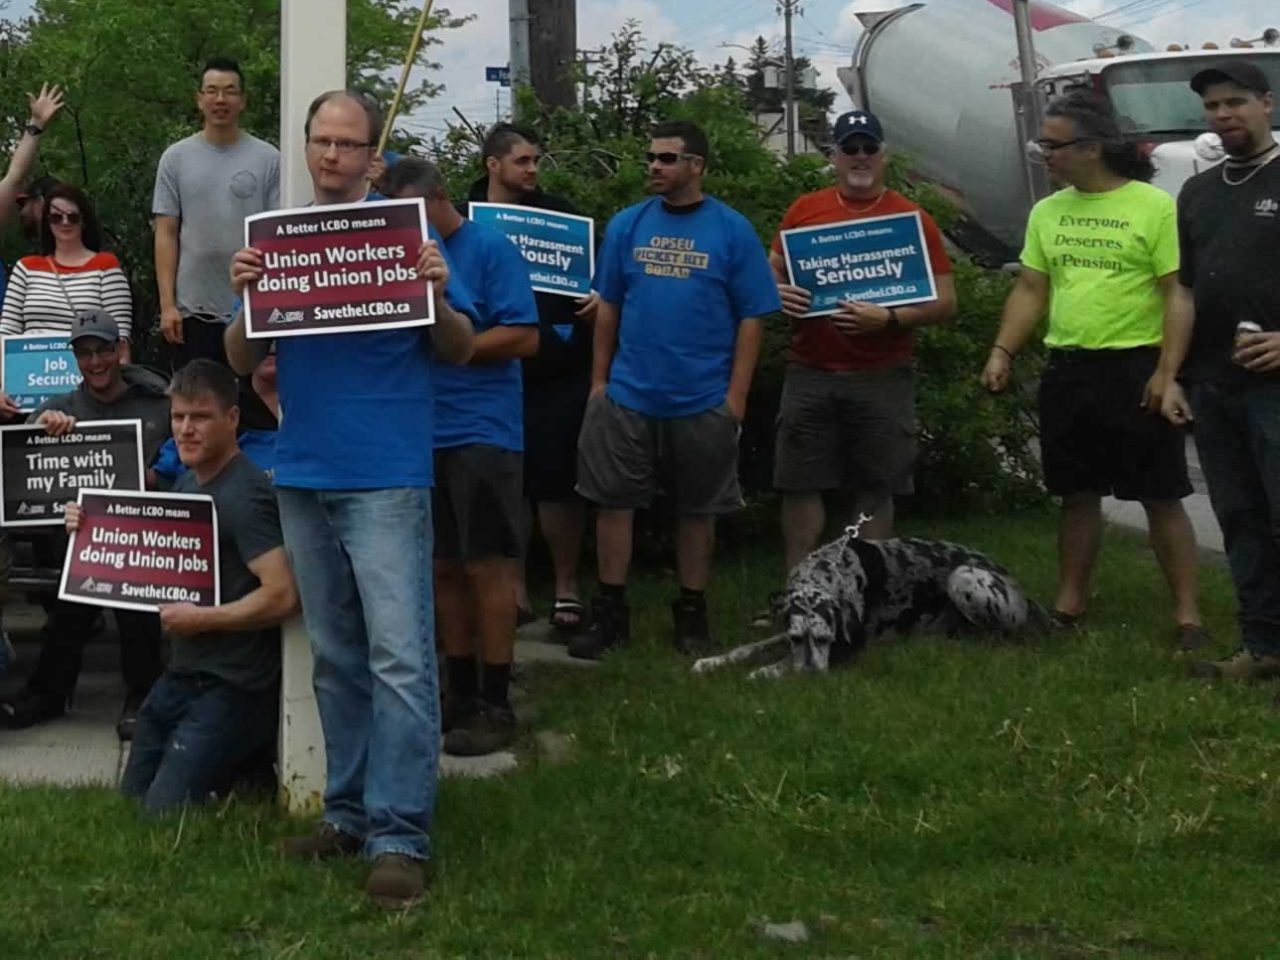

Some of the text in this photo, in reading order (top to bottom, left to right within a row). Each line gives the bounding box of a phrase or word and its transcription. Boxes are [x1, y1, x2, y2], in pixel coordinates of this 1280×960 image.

[276, 217, 387, 236] A Better LCBO means
[1058, 214, 1130, 231] Everyone
[519, 233, 585, 255] Harassment
[650, 235, 696, 251] OPSEU
[1054, 233, 1123, 250] Deserves
[264, 242, 406, 269] Union Workers
[797, 244, 917, 272] Taking Harassment
[1062, 254, 1122, 272] Pension
[257, 263, 418, 293] doing Union Jobs
[815, 259, 904, 286] Seriously
[314, 300, 410, 321] SavetheLCBO.ca
[44, 356, 68, 373] Job
[27, 371, 84, 391] Security
[27, 436, 34, 445] A
[61, 434, 83, 443] LCBO
[26, 449, 113, 471] Time with
[26, 470, 116, 493] my Family
[107, 504, 190, 518] A Better LCBO means
[91, 527, 201, 551] Union Workers
[79, 546, 208, 573] doing Union Jobs
[121, 583, 200, 602] SavetheLCBO.ca
